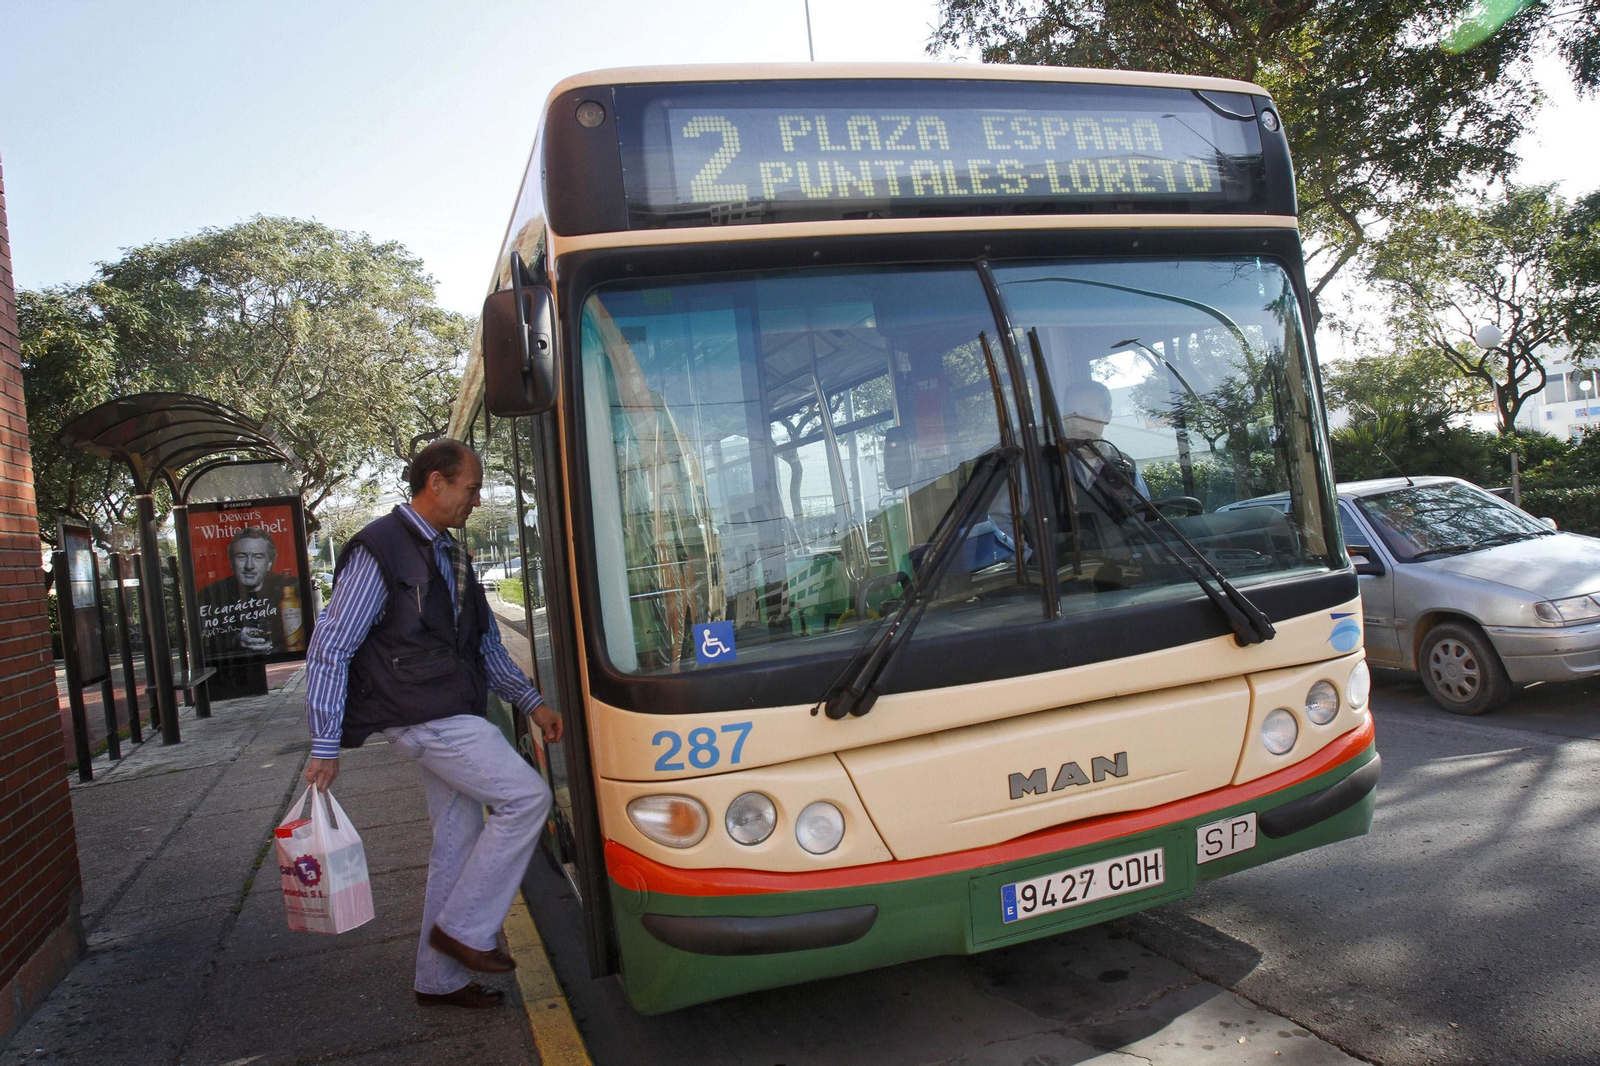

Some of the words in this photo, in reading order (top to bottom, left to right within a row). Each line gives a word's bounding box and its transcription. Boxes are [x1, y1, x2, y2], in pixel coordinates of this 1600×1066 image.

[777, 115, 950, 152] PLAZA
[981, 115, 1164, 151] ESPAÑA
[682, 115, 747, 202] 2
[759, 158, 1213, 200] PUNTALES-LORETO
[219, 510, 261, 523] Dewar's
[200, 604, 212, 617] El
[214, 598, 268, 614] carácter
[205, 617, 219, 628] no
[222, 614, 237, 625] se
[240, 603, 277, 621] regala
[651, 721, 753, 772] 287
[1008, 751, 1129, 800] MAN
[1007, 906, 1015, 916] E
[1020, 869, 1096, 913] 9427
[1107, 852, 1161, 891] CDH
